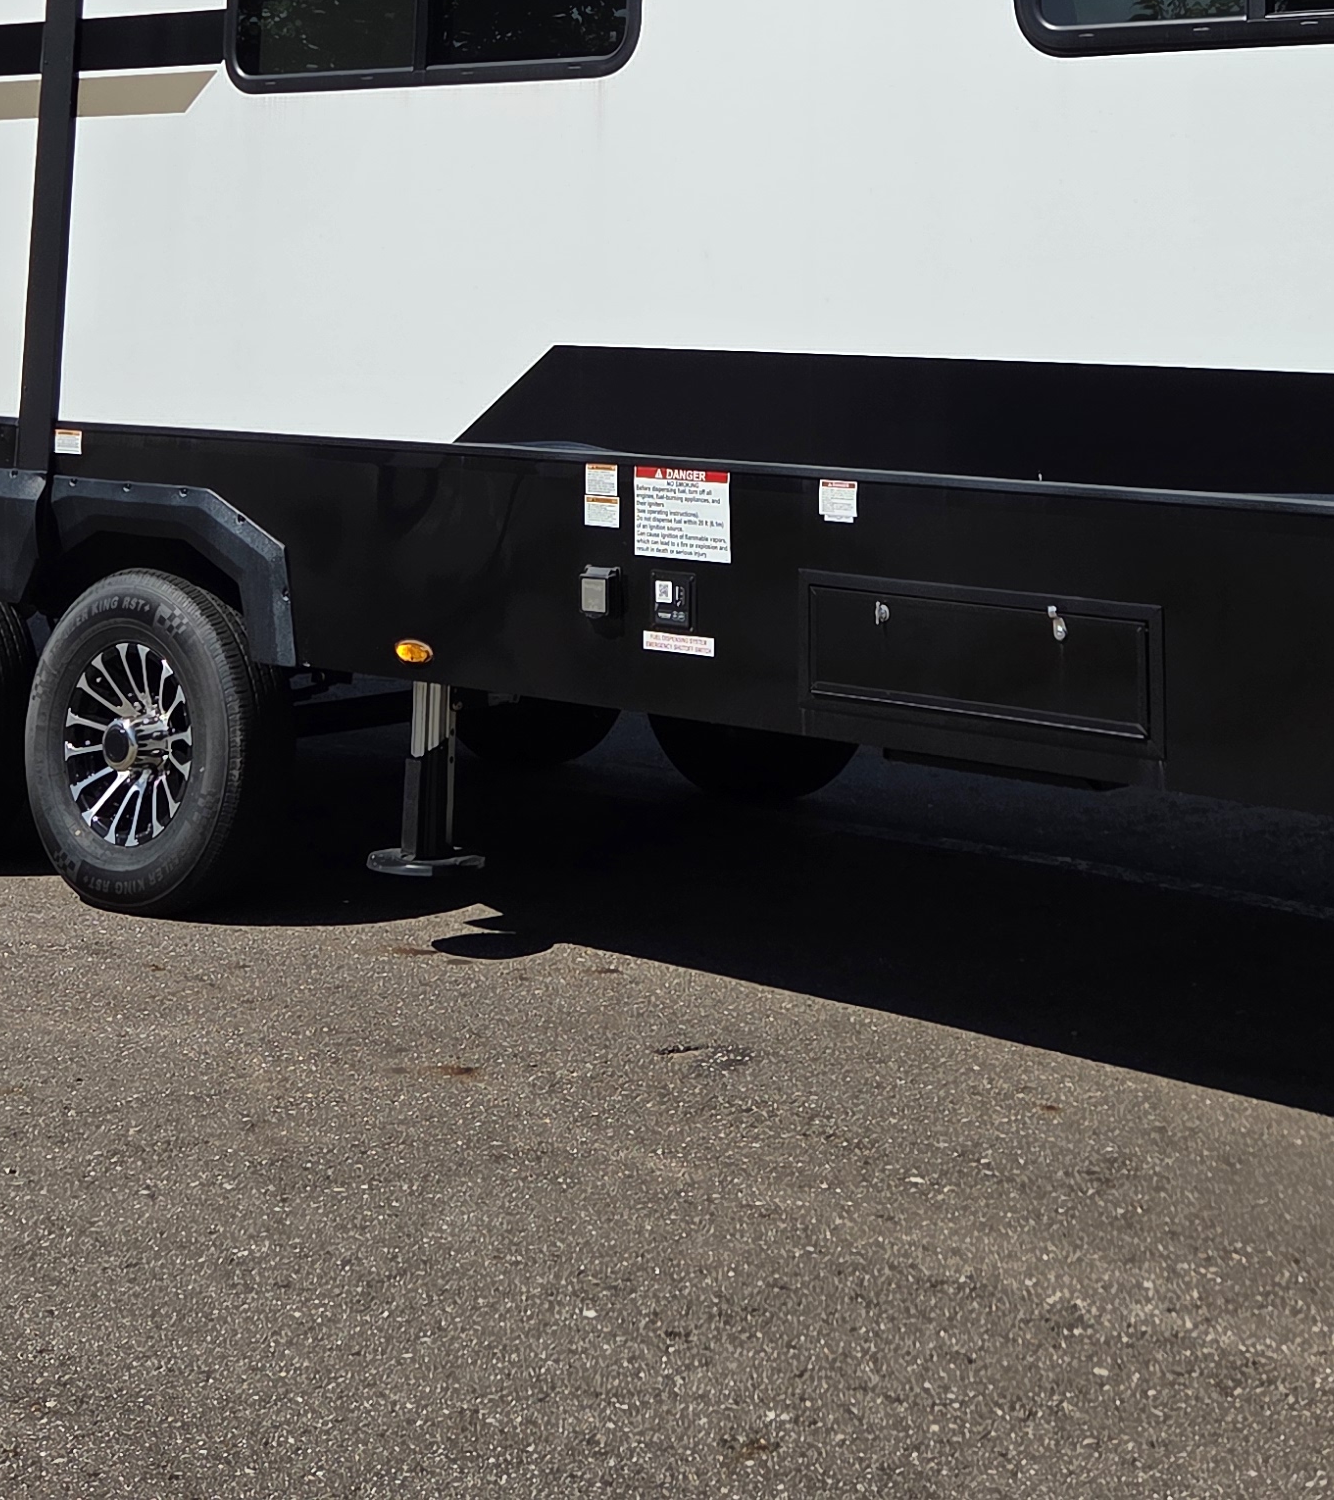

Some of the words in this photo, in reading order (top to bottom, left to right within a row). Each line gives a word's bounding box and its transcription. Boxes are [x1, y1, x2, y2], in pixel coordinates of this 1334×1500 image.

[666, 469, 706, 481] DANGER
[91, 596, 119, 616] KING
[115, 879, 146, 895] KING
